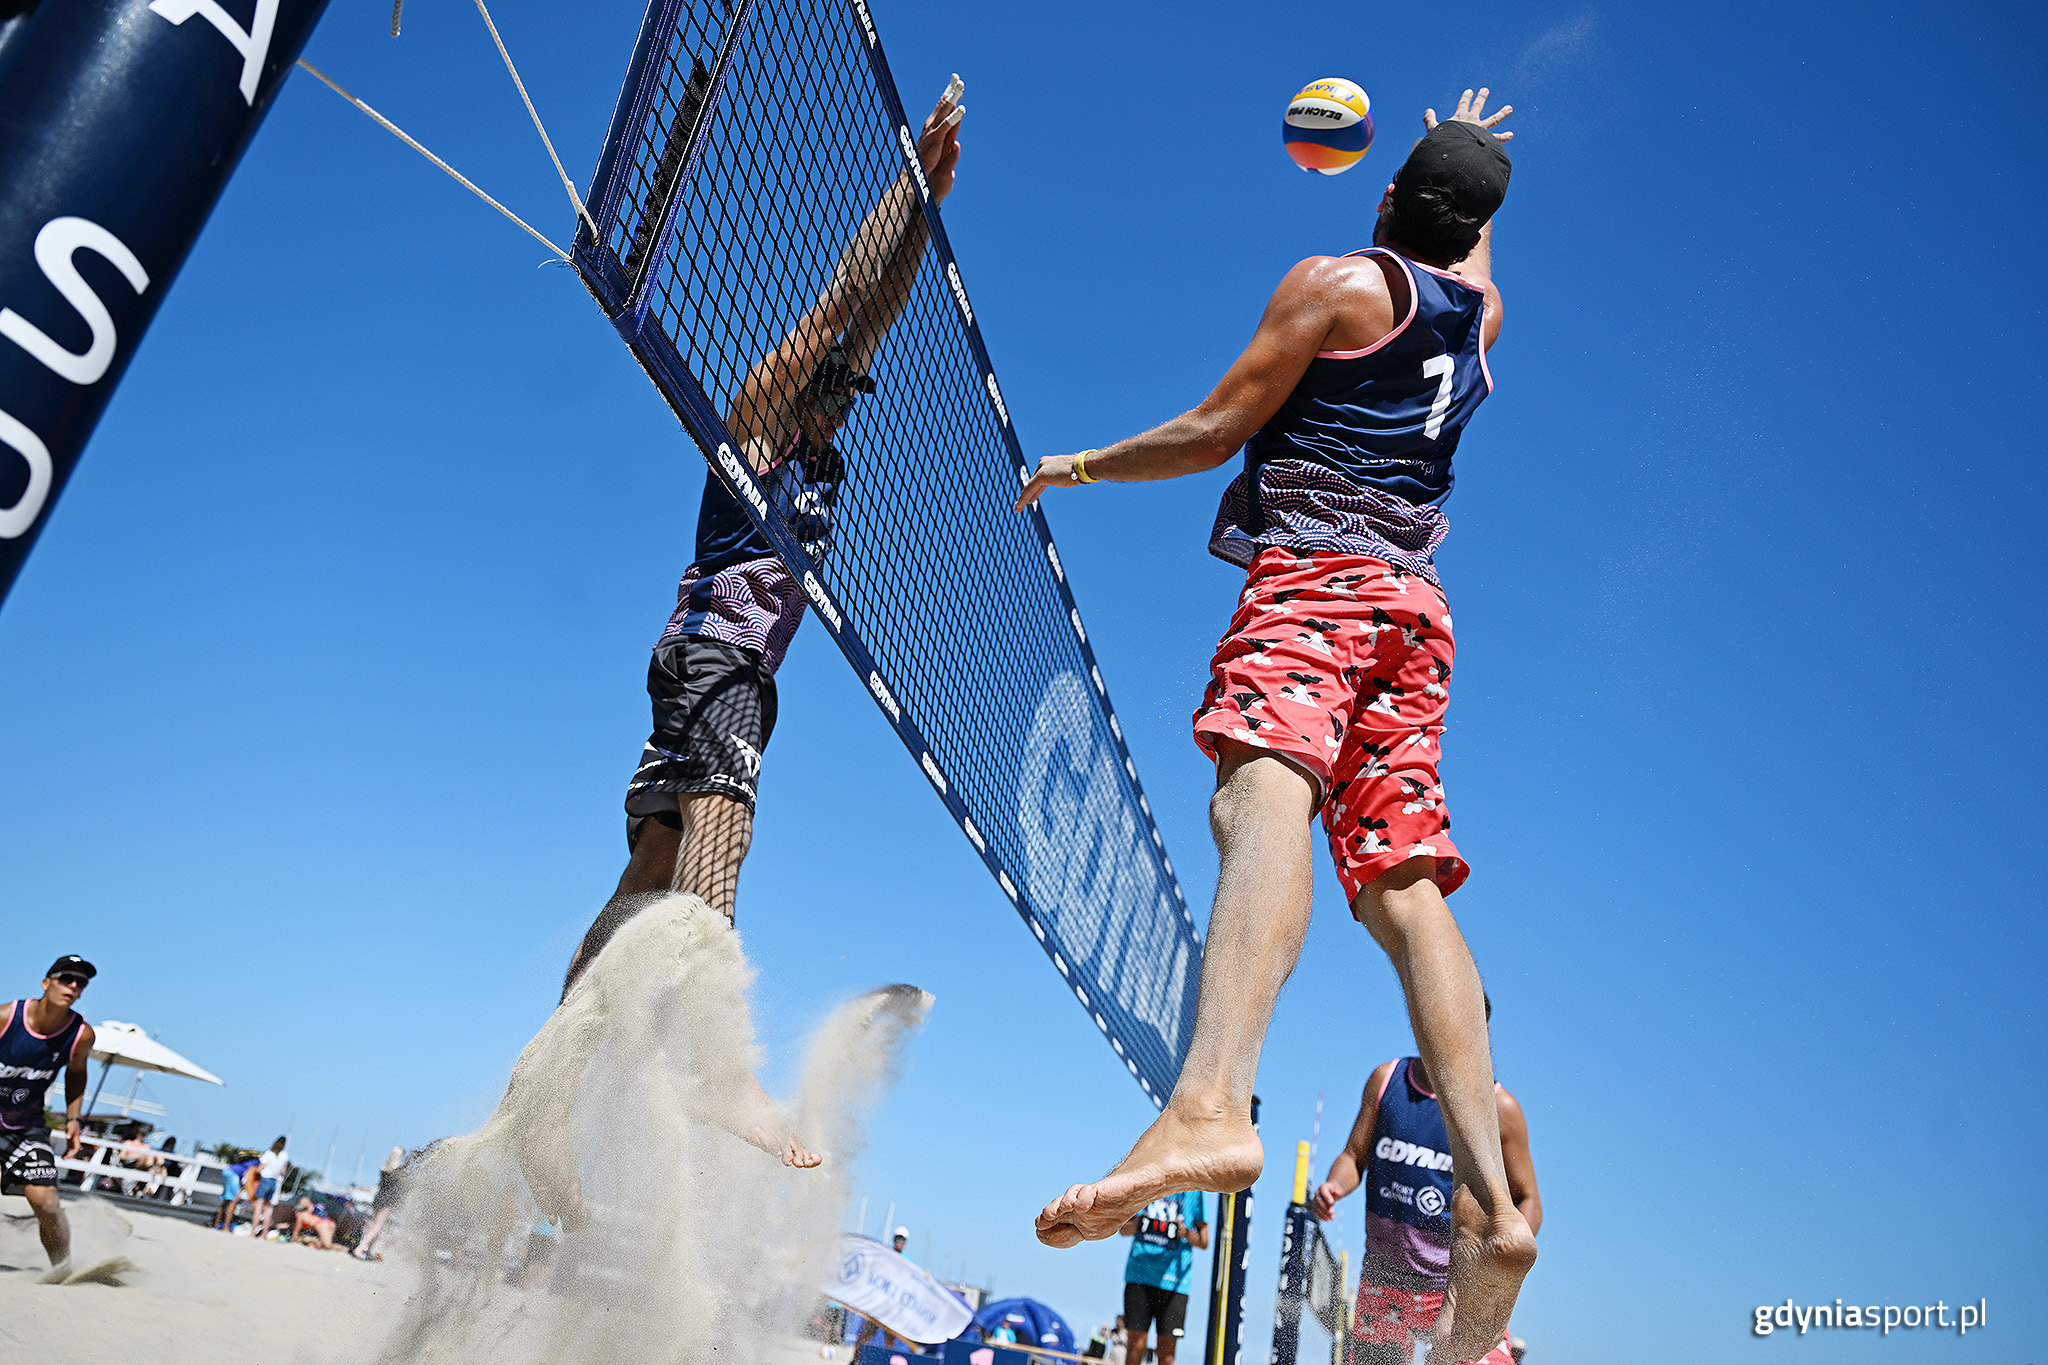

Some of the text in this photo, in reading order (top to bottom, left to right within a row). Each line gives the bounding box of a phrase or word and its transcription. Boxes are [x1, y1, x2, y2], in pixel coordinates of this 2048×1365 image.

[1304, 106, 1344, 121] BEACH
[900, 124, 931, 204] GDYNIA
[947, 262, 973, 327] GDYNIA
[716, 441, 769, 522] GDYNIA
[803, 570, 843, 634] GDYNIA
